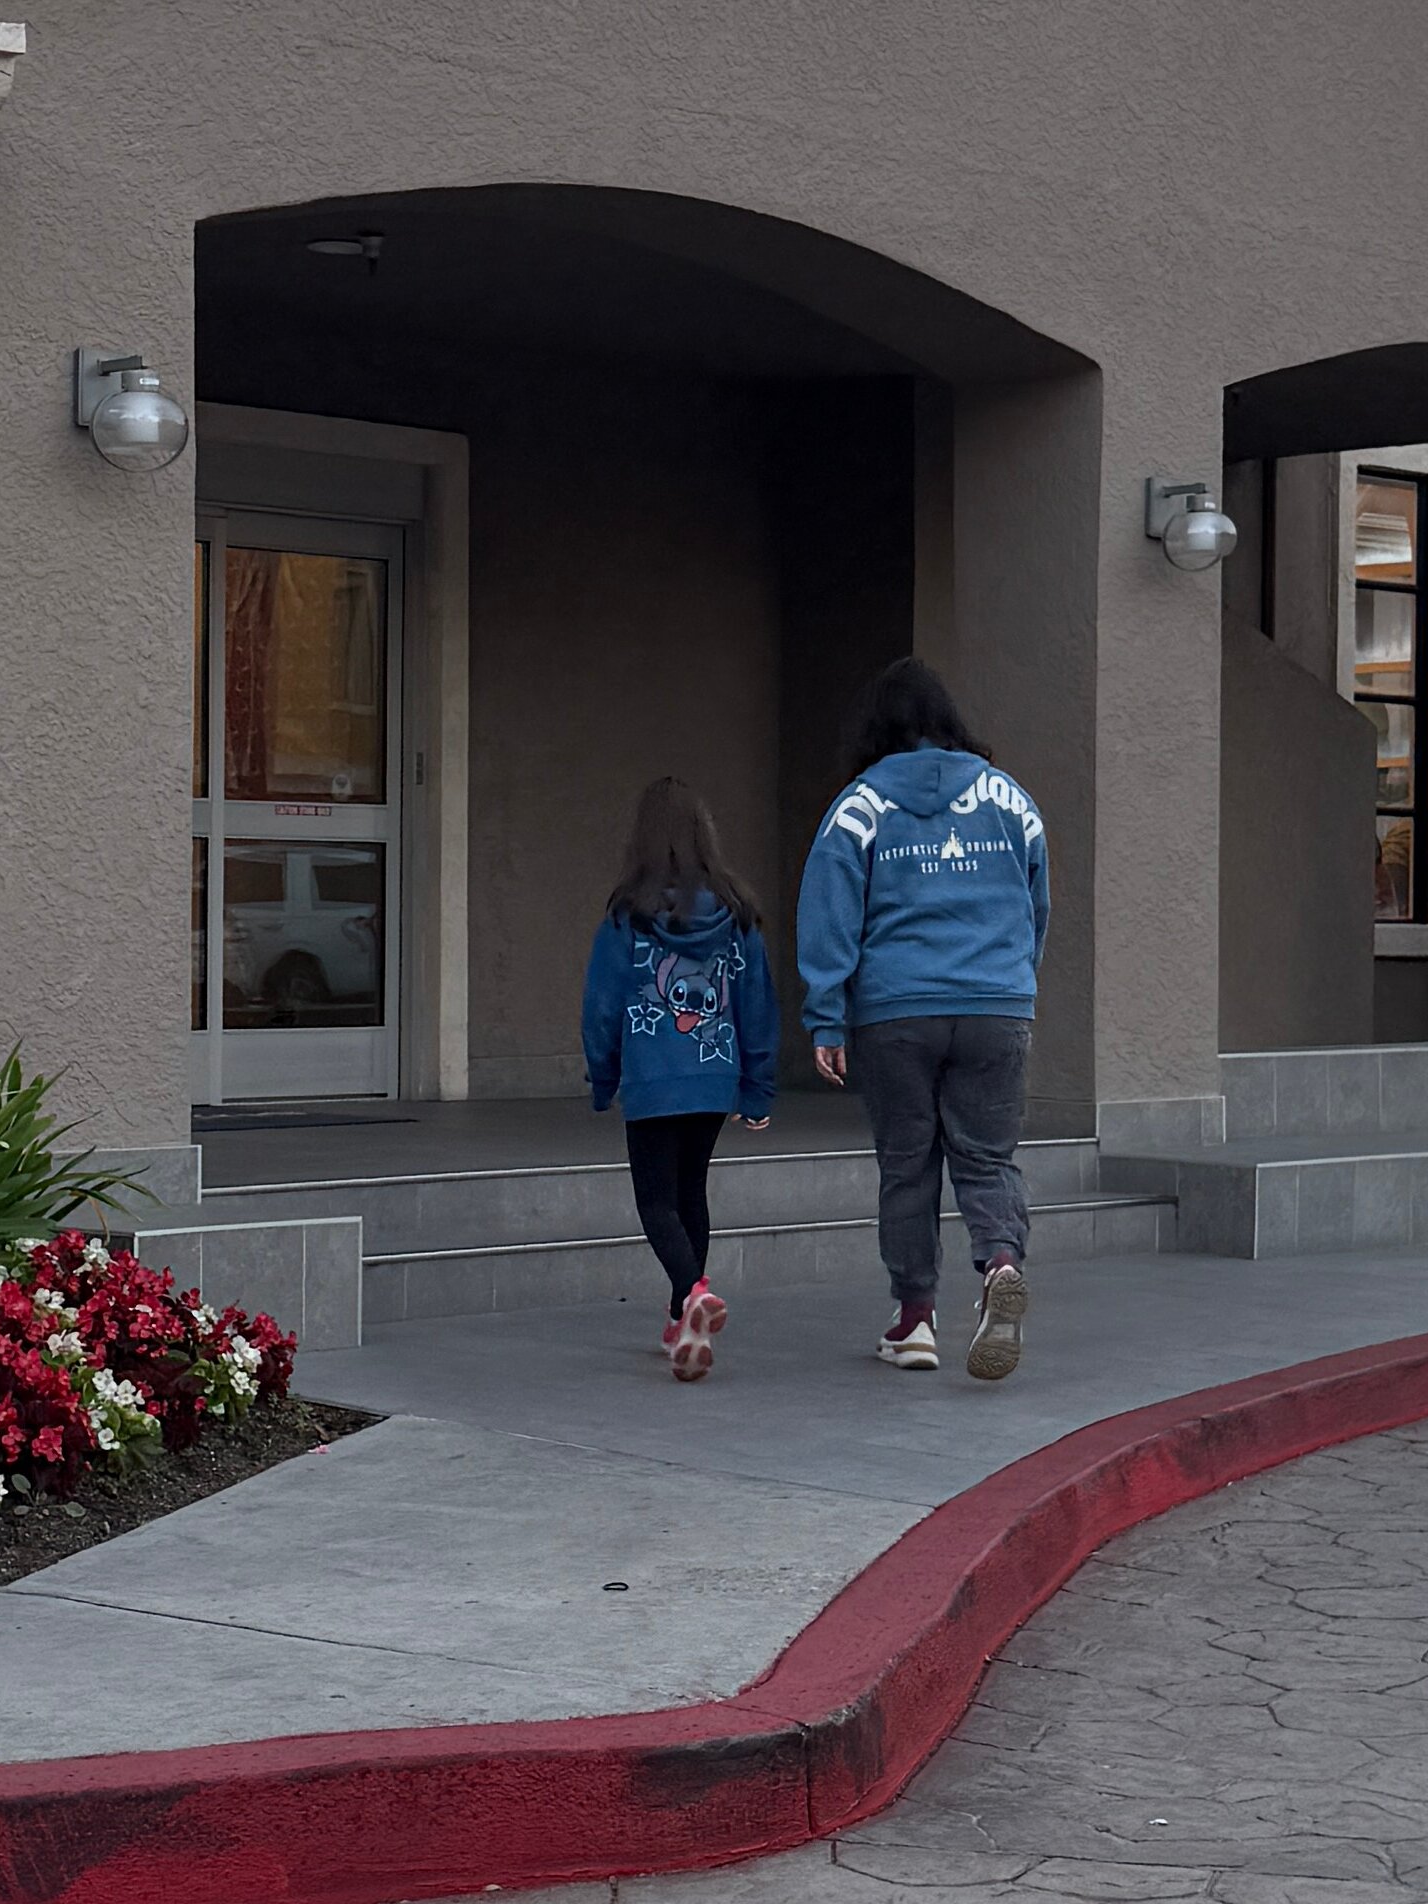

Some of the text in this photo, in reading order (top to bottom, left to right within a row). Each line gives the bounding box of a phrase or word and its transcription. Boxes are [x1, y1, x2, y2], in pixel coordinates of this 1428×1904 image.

[823, 771, 1044, 850] Diyland
[879, 844, 939, 862] AUTHENTIC
[921, 862, 939, 873] EST
